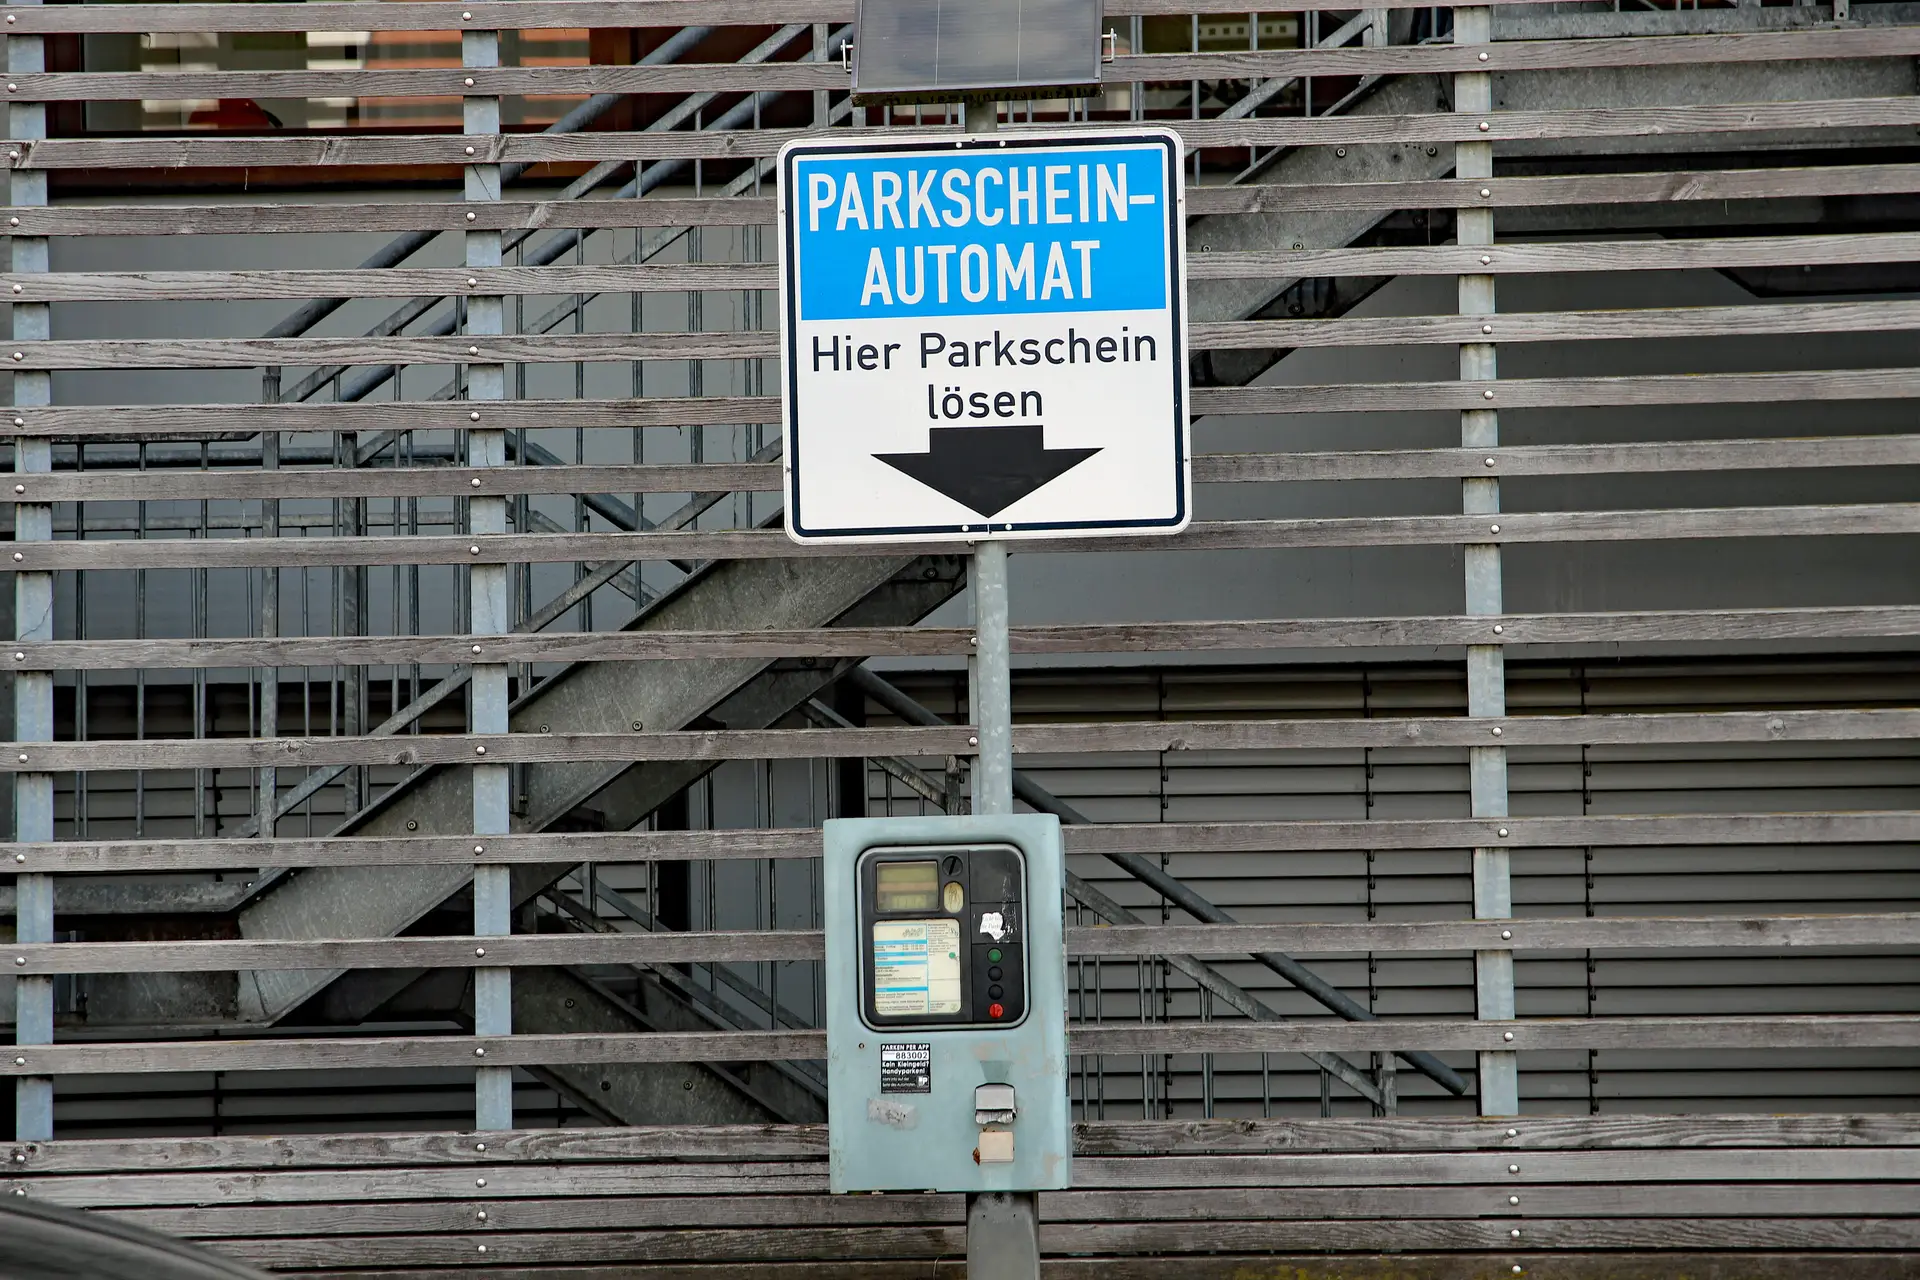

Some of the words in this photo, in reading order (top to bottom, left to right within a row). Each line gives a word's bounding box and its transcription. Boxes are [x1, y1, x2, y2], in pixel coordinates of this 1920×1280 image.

[807, 162, 1156, 231] PARKSCHEIN-
[860, 239, 1100, 306] AUTOMAT
[812, 334, 901, 372] Hier
[920, 326, 1156, 369] Parkschein
[928, 384, 1043, 420] lösen
